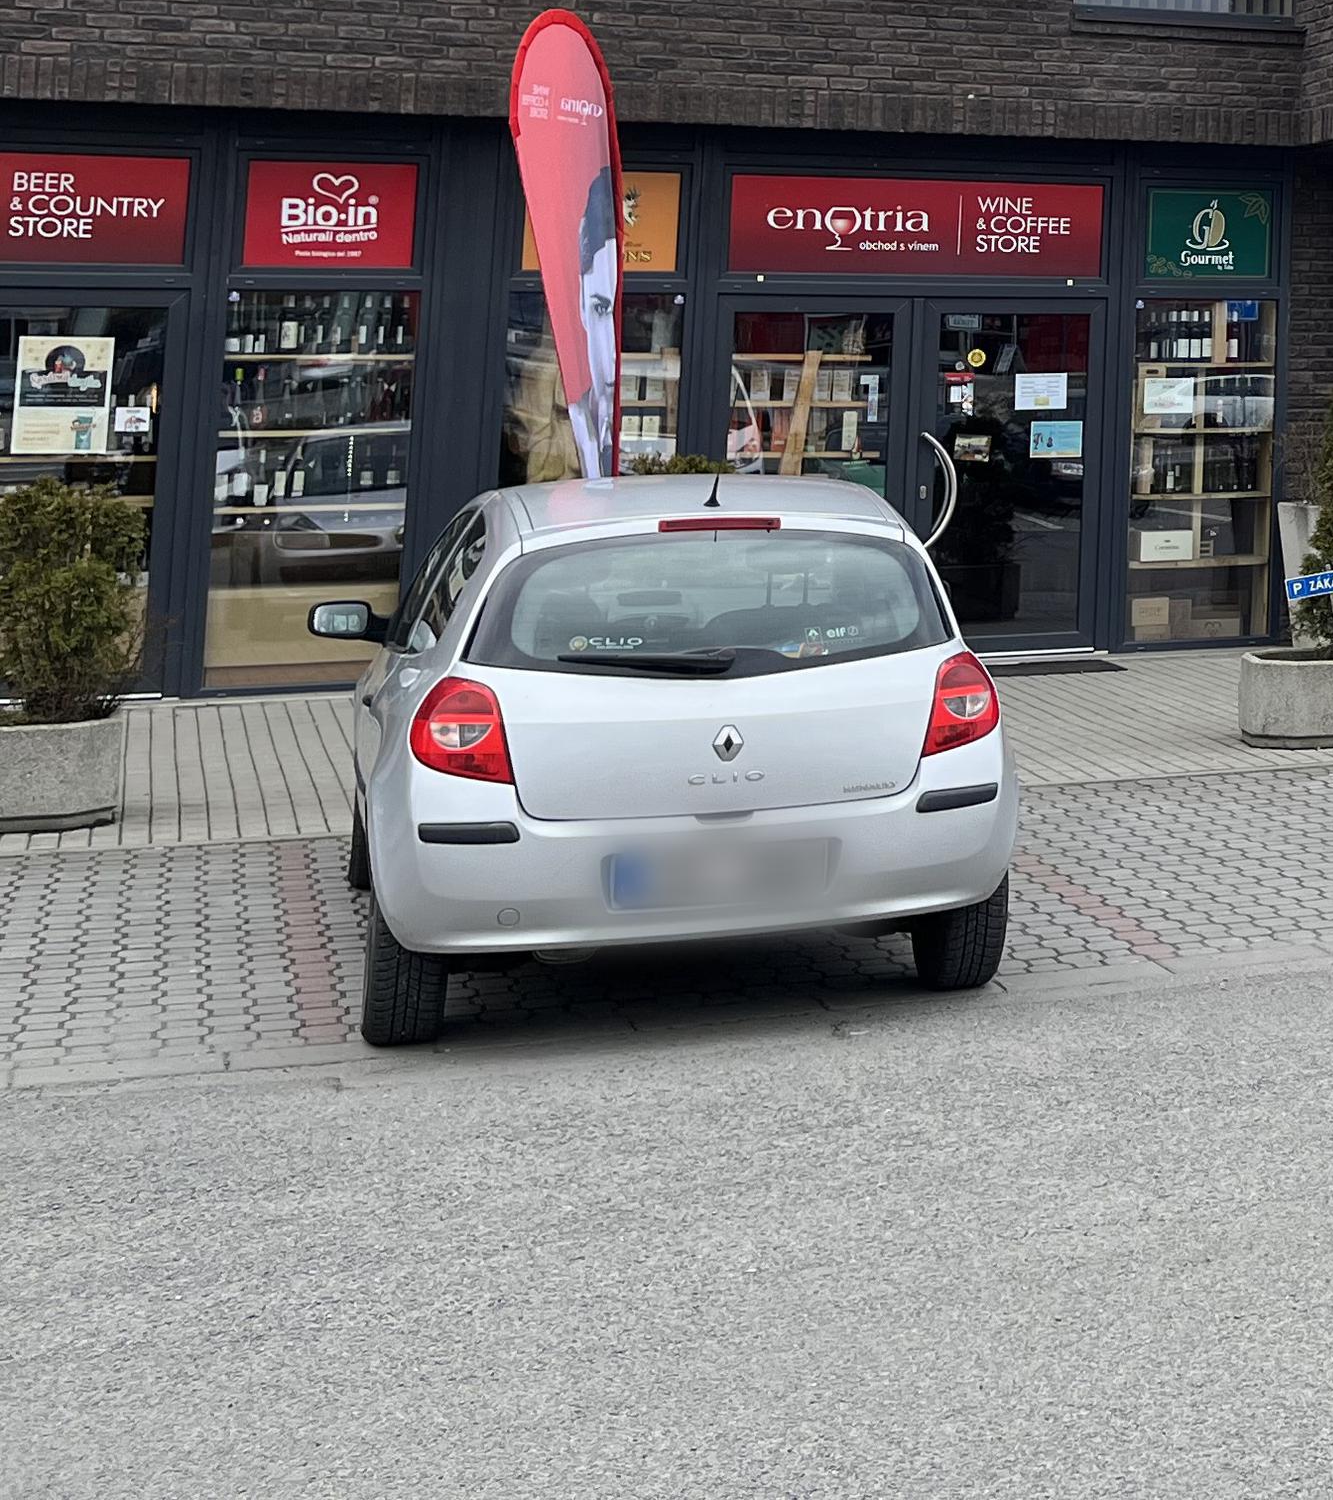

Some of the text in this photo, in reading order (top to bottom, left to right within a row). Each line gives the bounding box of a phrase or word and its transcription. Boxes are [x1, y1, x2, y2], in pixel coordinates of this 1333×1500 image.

[12, 171, 75, 193] BEER
[9, 194, 166, 218] & COUNTRY
[976, 195, 1034, 216] WINE
[8, 216, 93, 239] STORE
[766, 204, 930, 238] enotria
[975, 216, 1072, 236] & COFFEE
[335, 230, 378, 243] dentro
[975, 235, 1041, 254] STORE
[858, 240, 898, 252] obchod
[1179, 249, 1235, 267] Gourmet
[1292, 582, 1303, 596] P
[588, 636, 644, 647] CLIO
[826, 626, 848, 639] elf
[687, 769, 766, 787] CLIO
